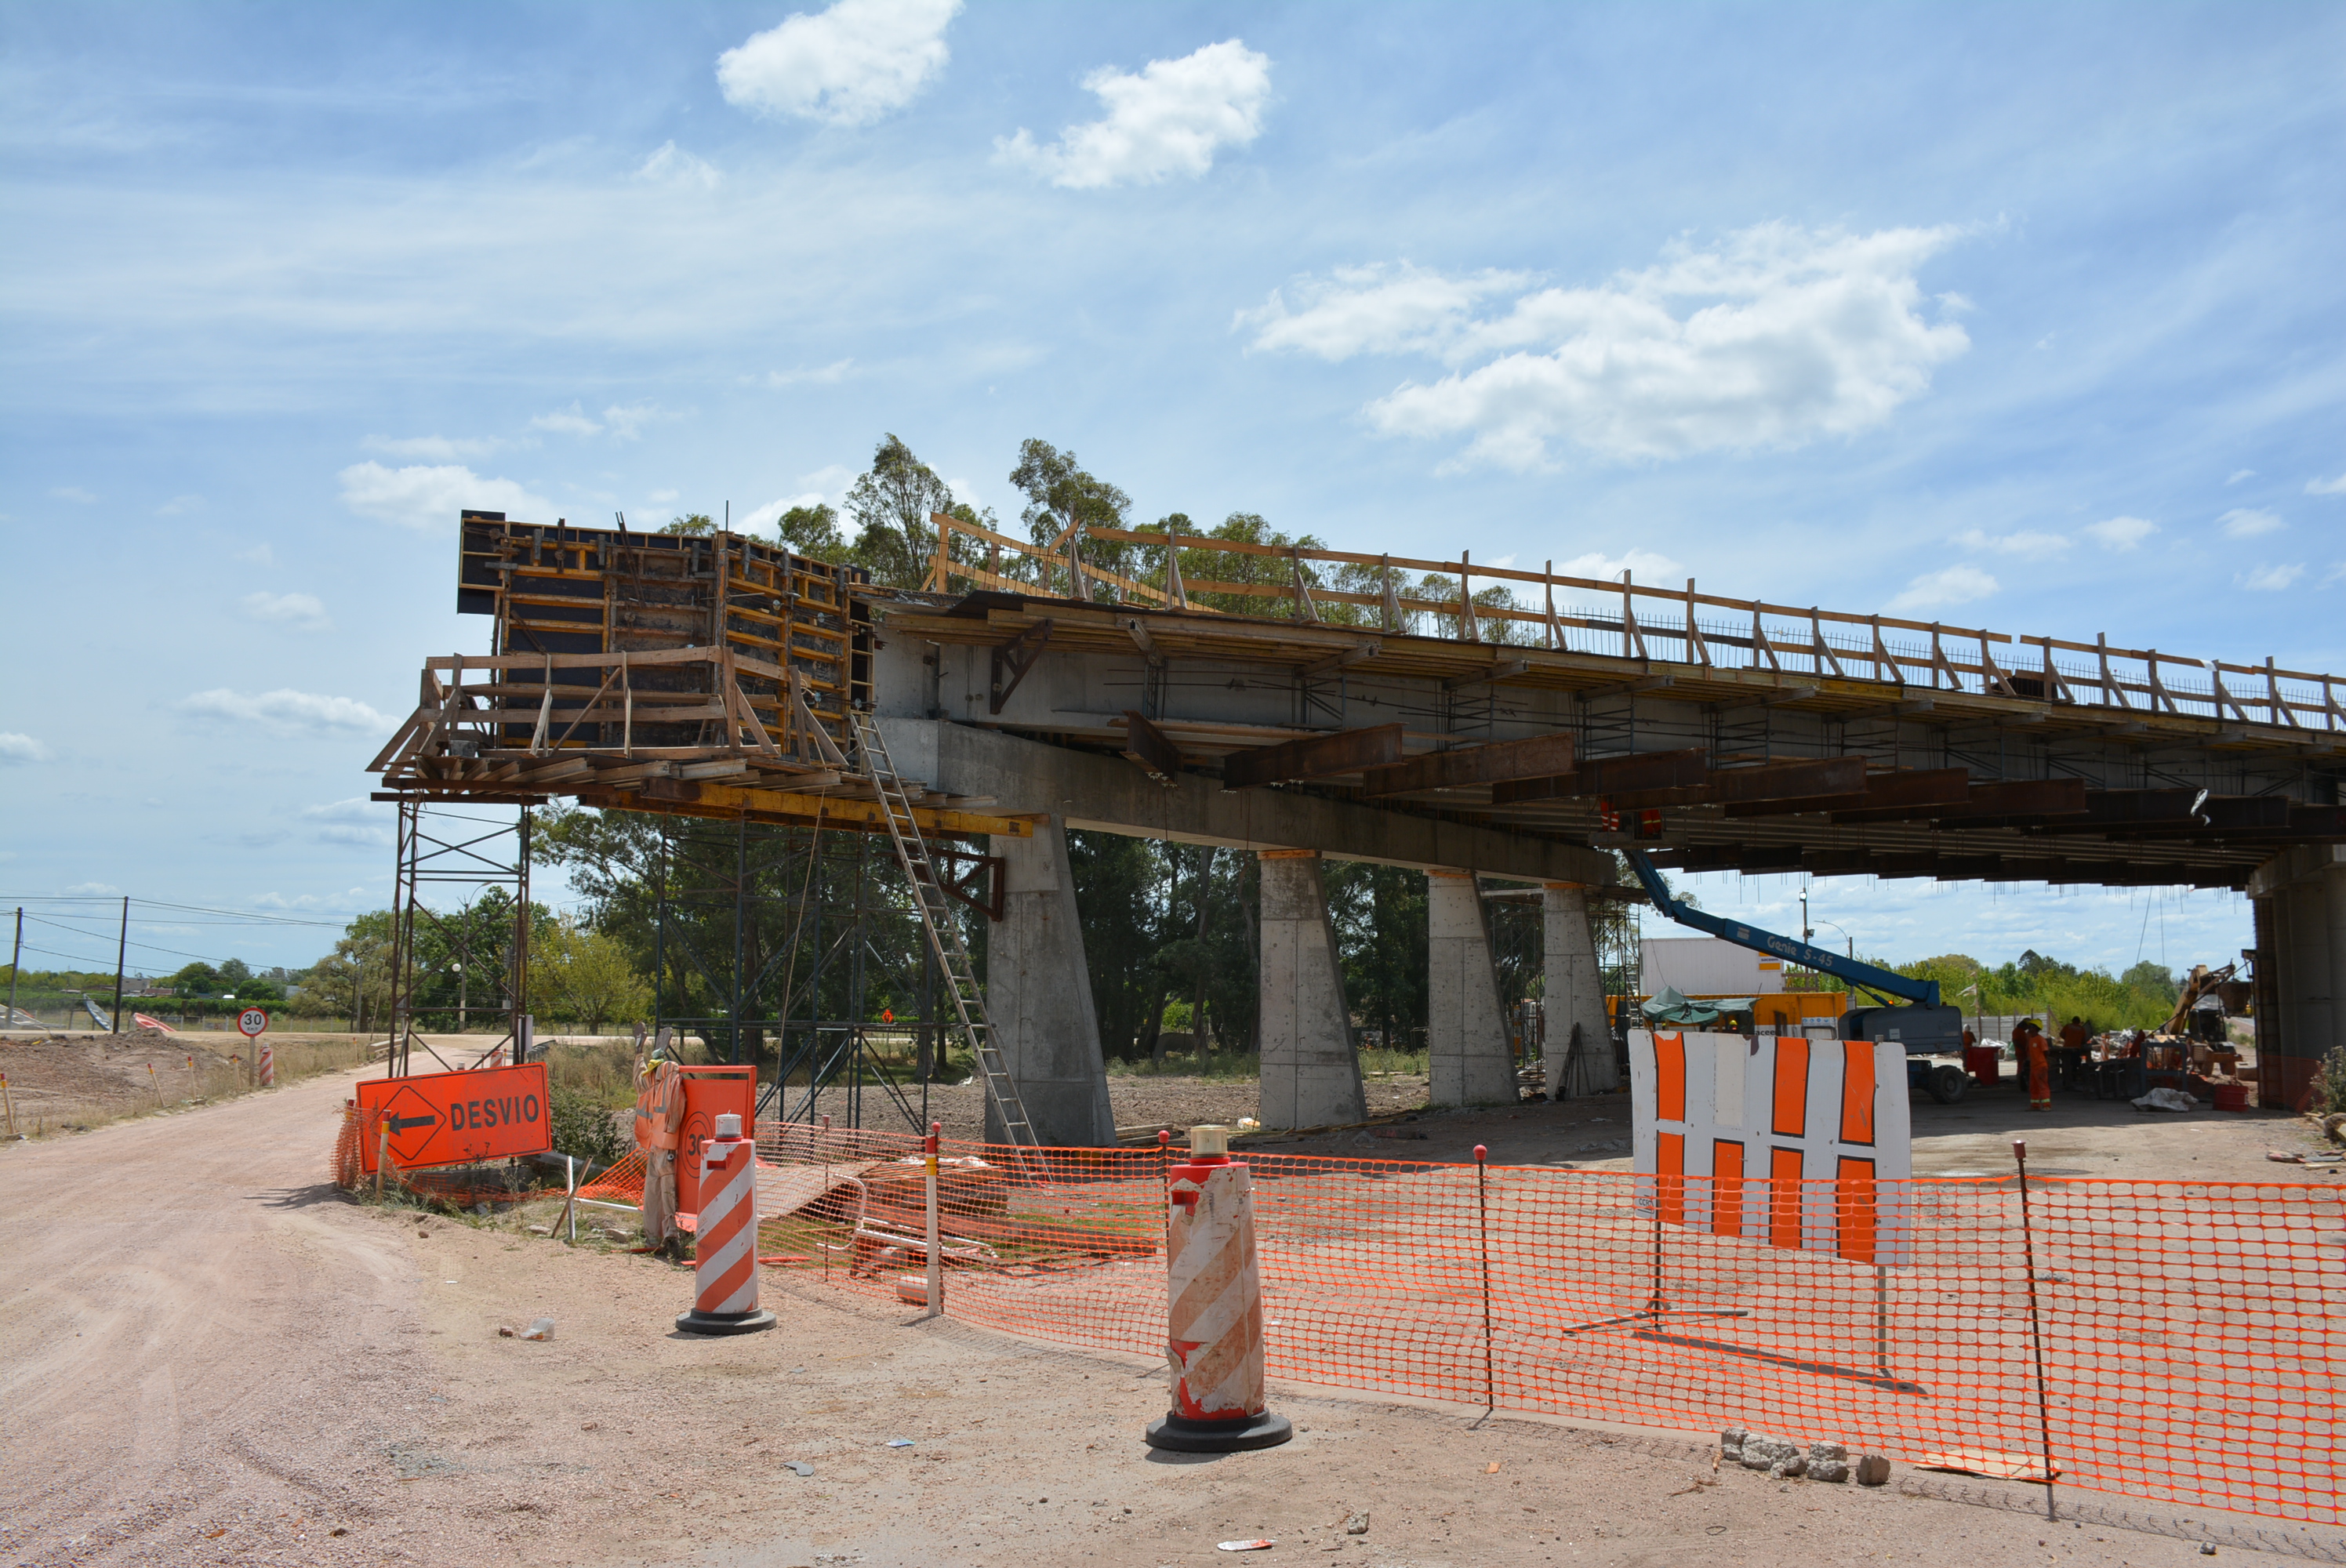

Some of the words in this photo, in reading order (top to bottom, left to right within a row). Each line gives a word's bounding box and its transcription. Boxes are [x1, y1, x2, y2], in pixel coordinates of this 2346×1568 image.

[1767, 935, 1797, 956] Genie
[244, 1014, 262, 1025] 30
[450, 1094, 539, 1131] DESVIO
[688, 1134, 706, 1156] 30
